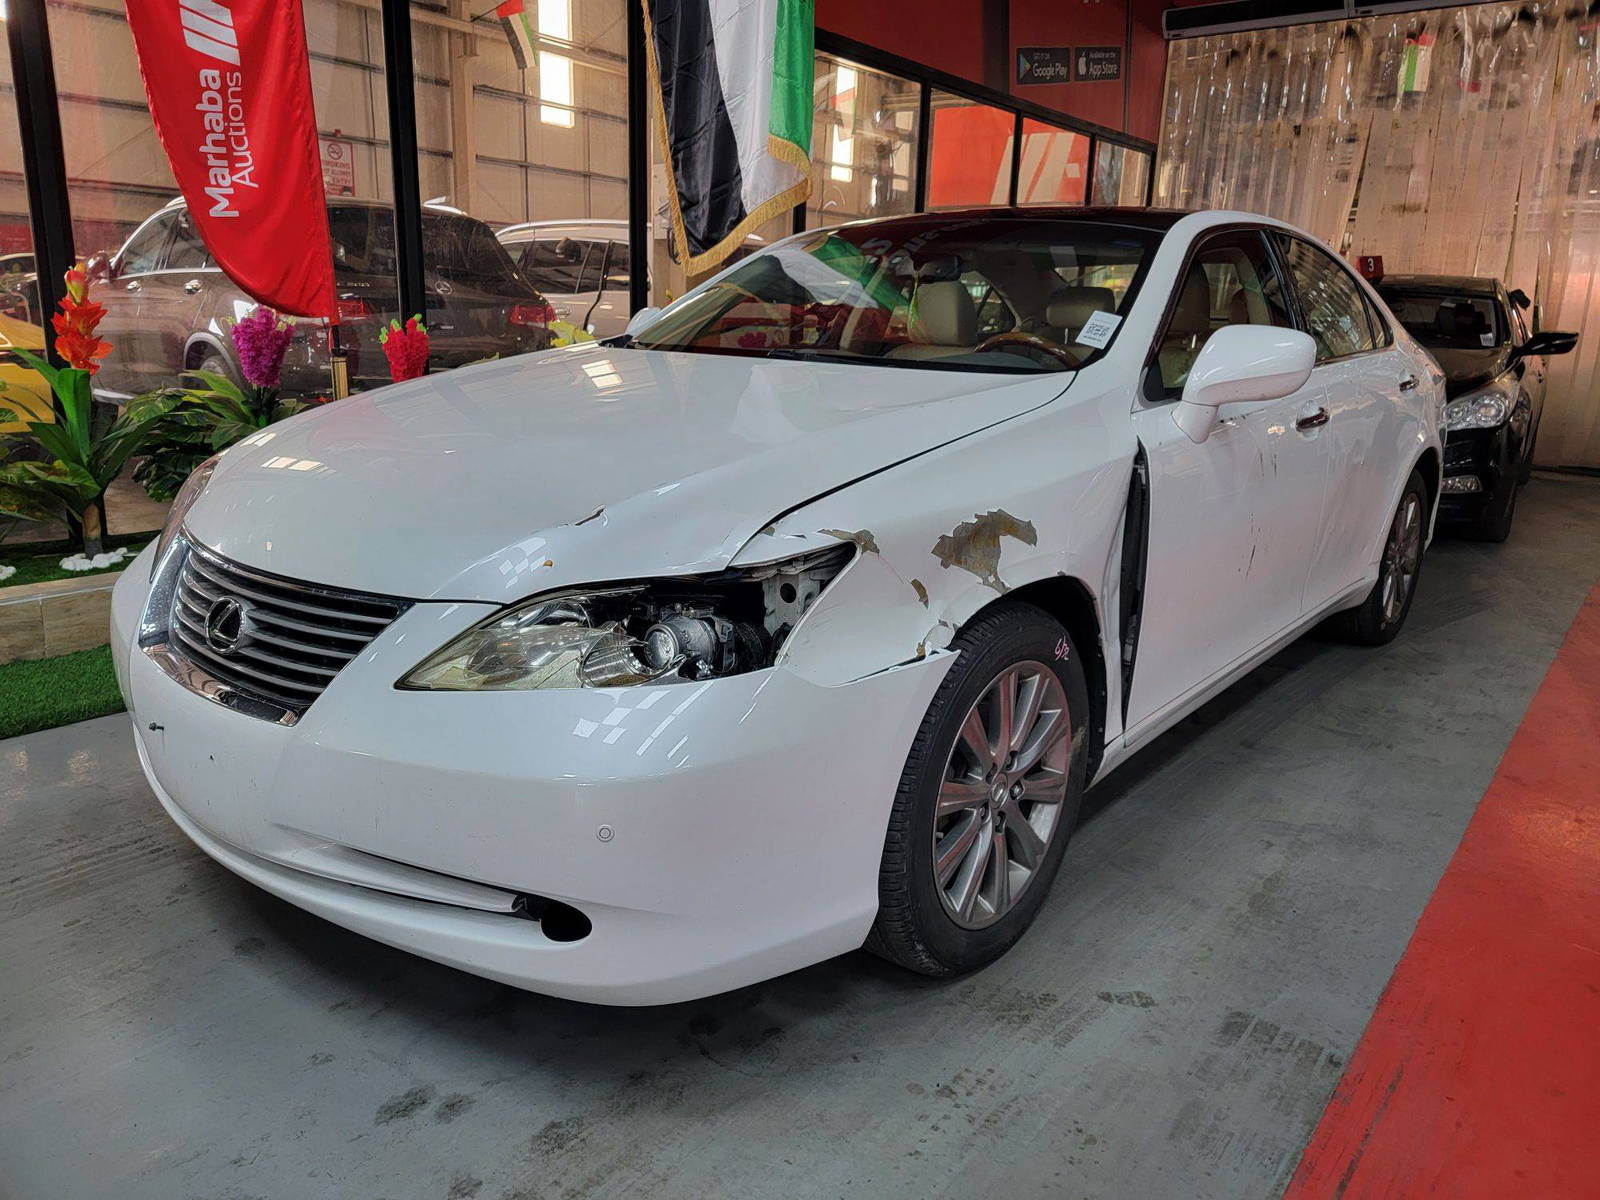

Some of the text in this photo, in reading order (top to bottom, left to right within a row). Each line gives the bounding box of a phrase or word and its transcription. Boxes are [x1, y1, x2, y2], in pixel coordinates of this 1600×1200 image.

[1032, 62, 1068, 80] Google Play
[1088, 61, 1118, 79] App Store
[224, 71, 259, 188] Auctions
[195, 68, 240, 218] Marhaba
[1367, 257, 1375, 272] 3
